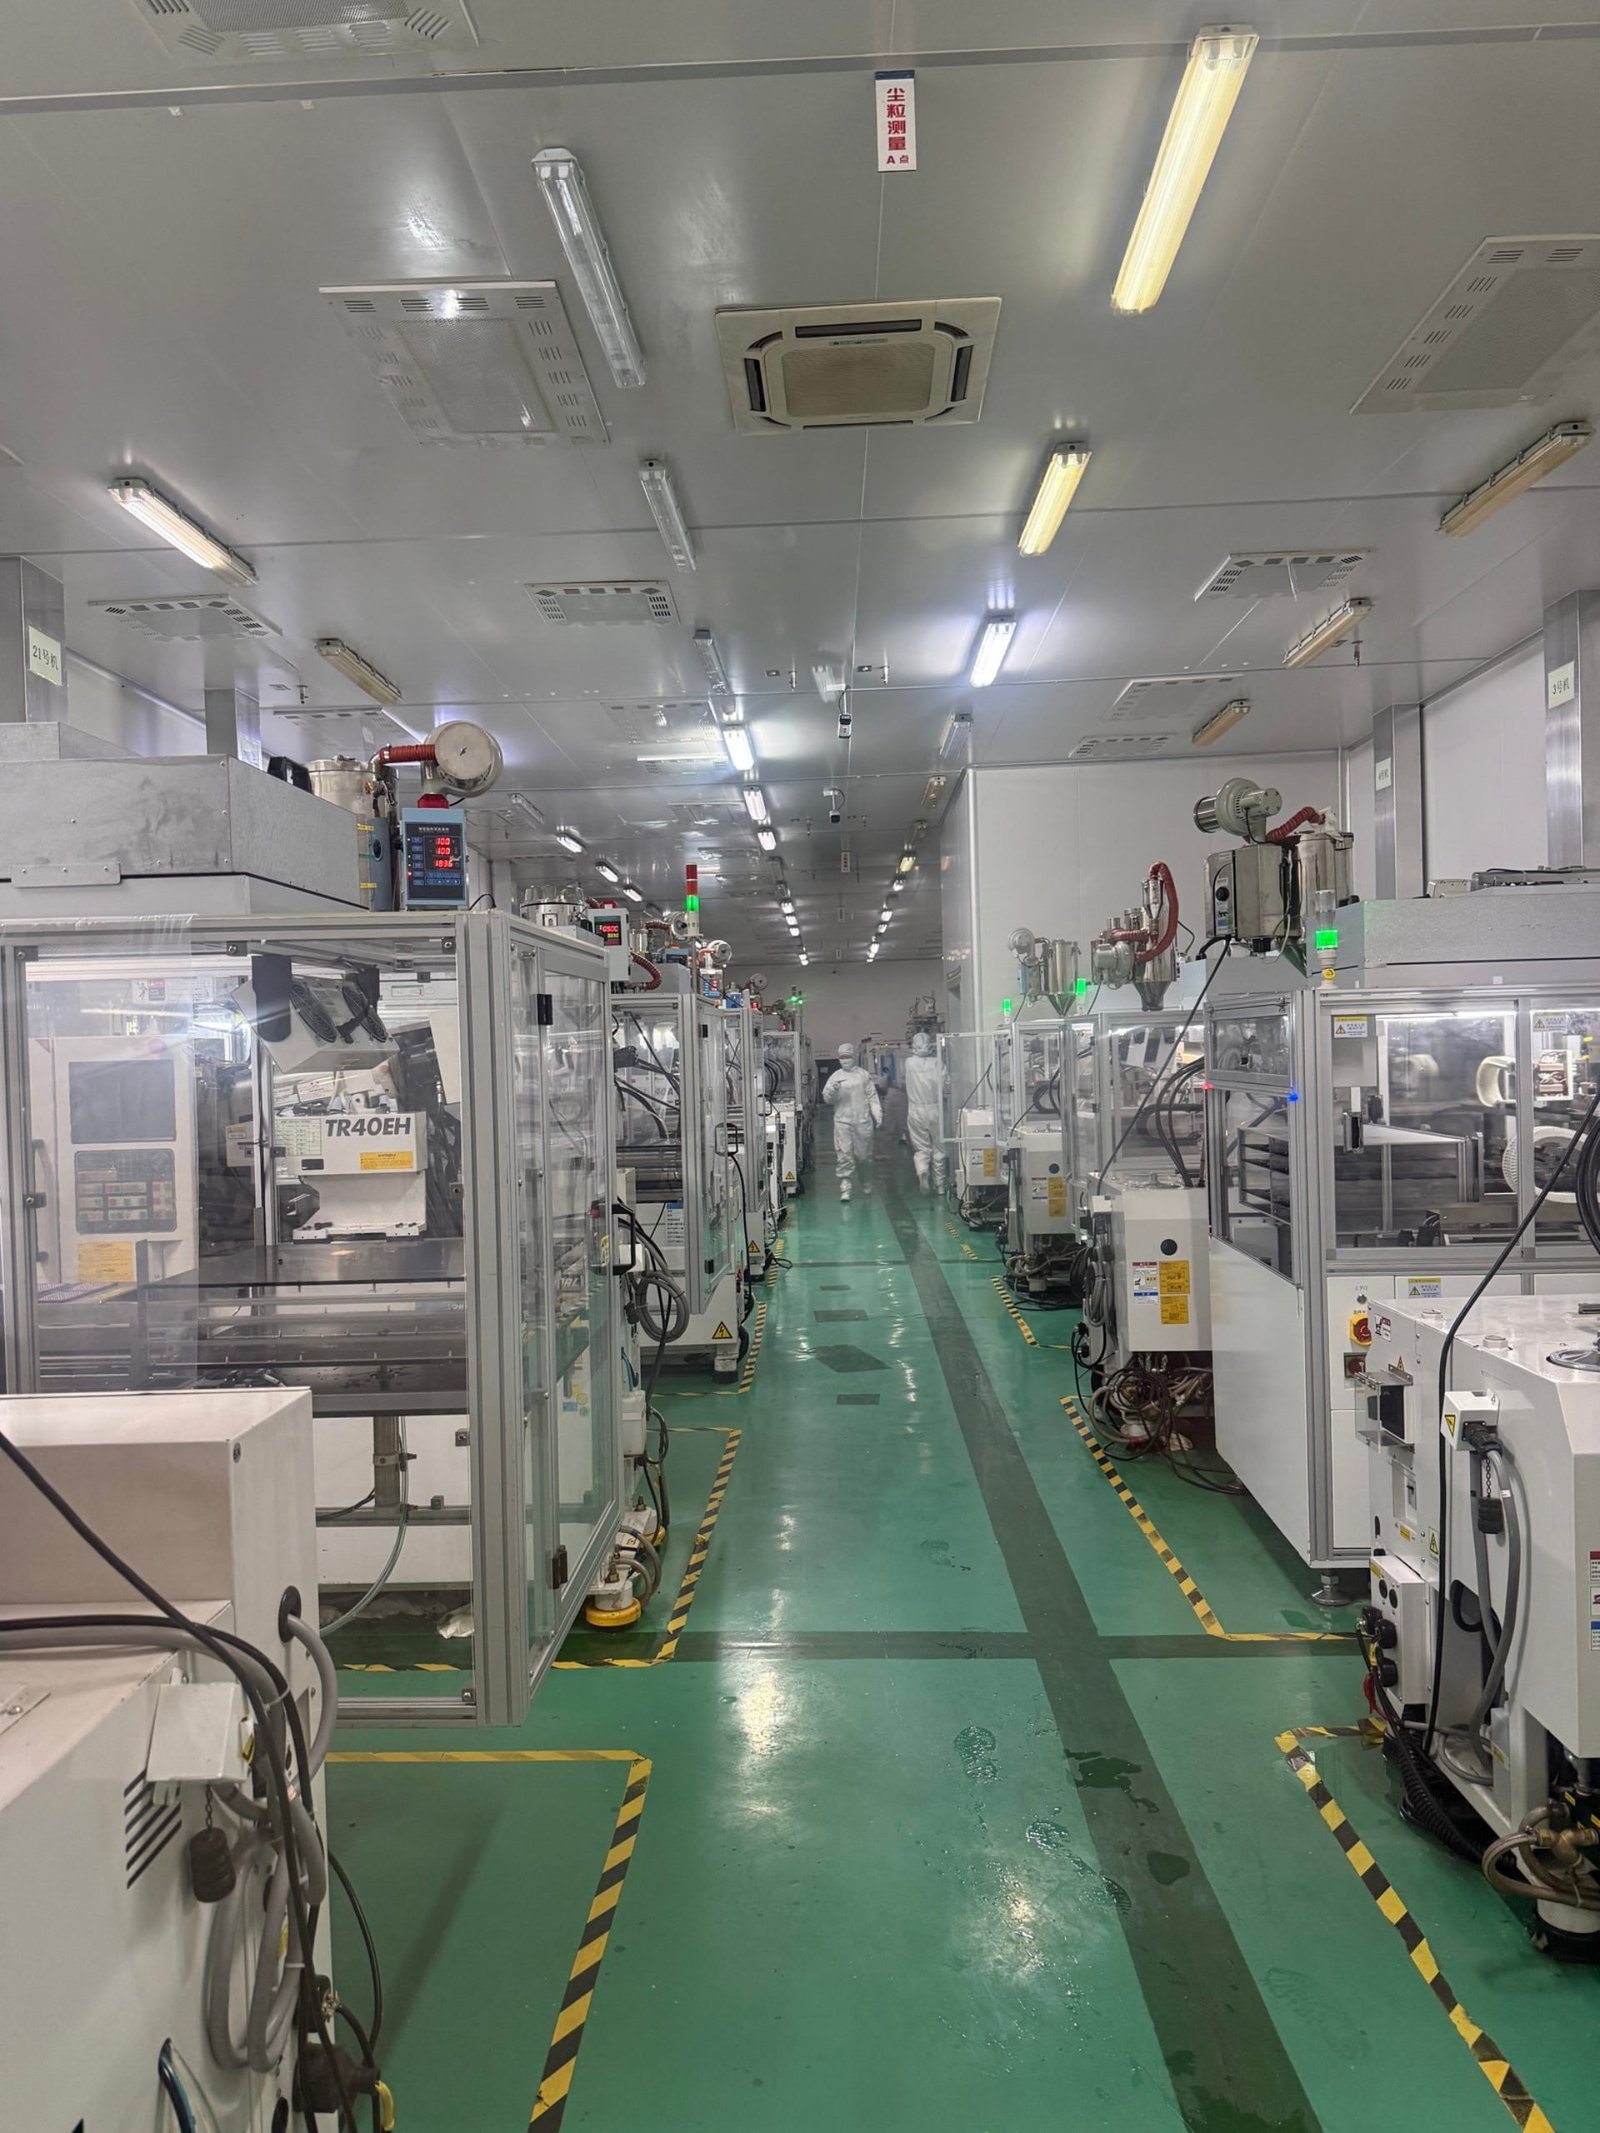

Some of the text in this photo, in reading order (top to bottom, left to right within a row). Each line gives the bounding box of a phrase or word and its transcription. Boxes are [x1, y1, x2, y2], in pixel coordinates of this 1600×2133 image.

[886, 87, 907, 151] 尘粒测量
[886, 154, 909, 164] A 点
[32, 644, 59, 671] 21号机
[435, 837, 451, 845] 100
[436, 847, 451, 855] 100
[325, 1117, 411, 1137] TR40EH
